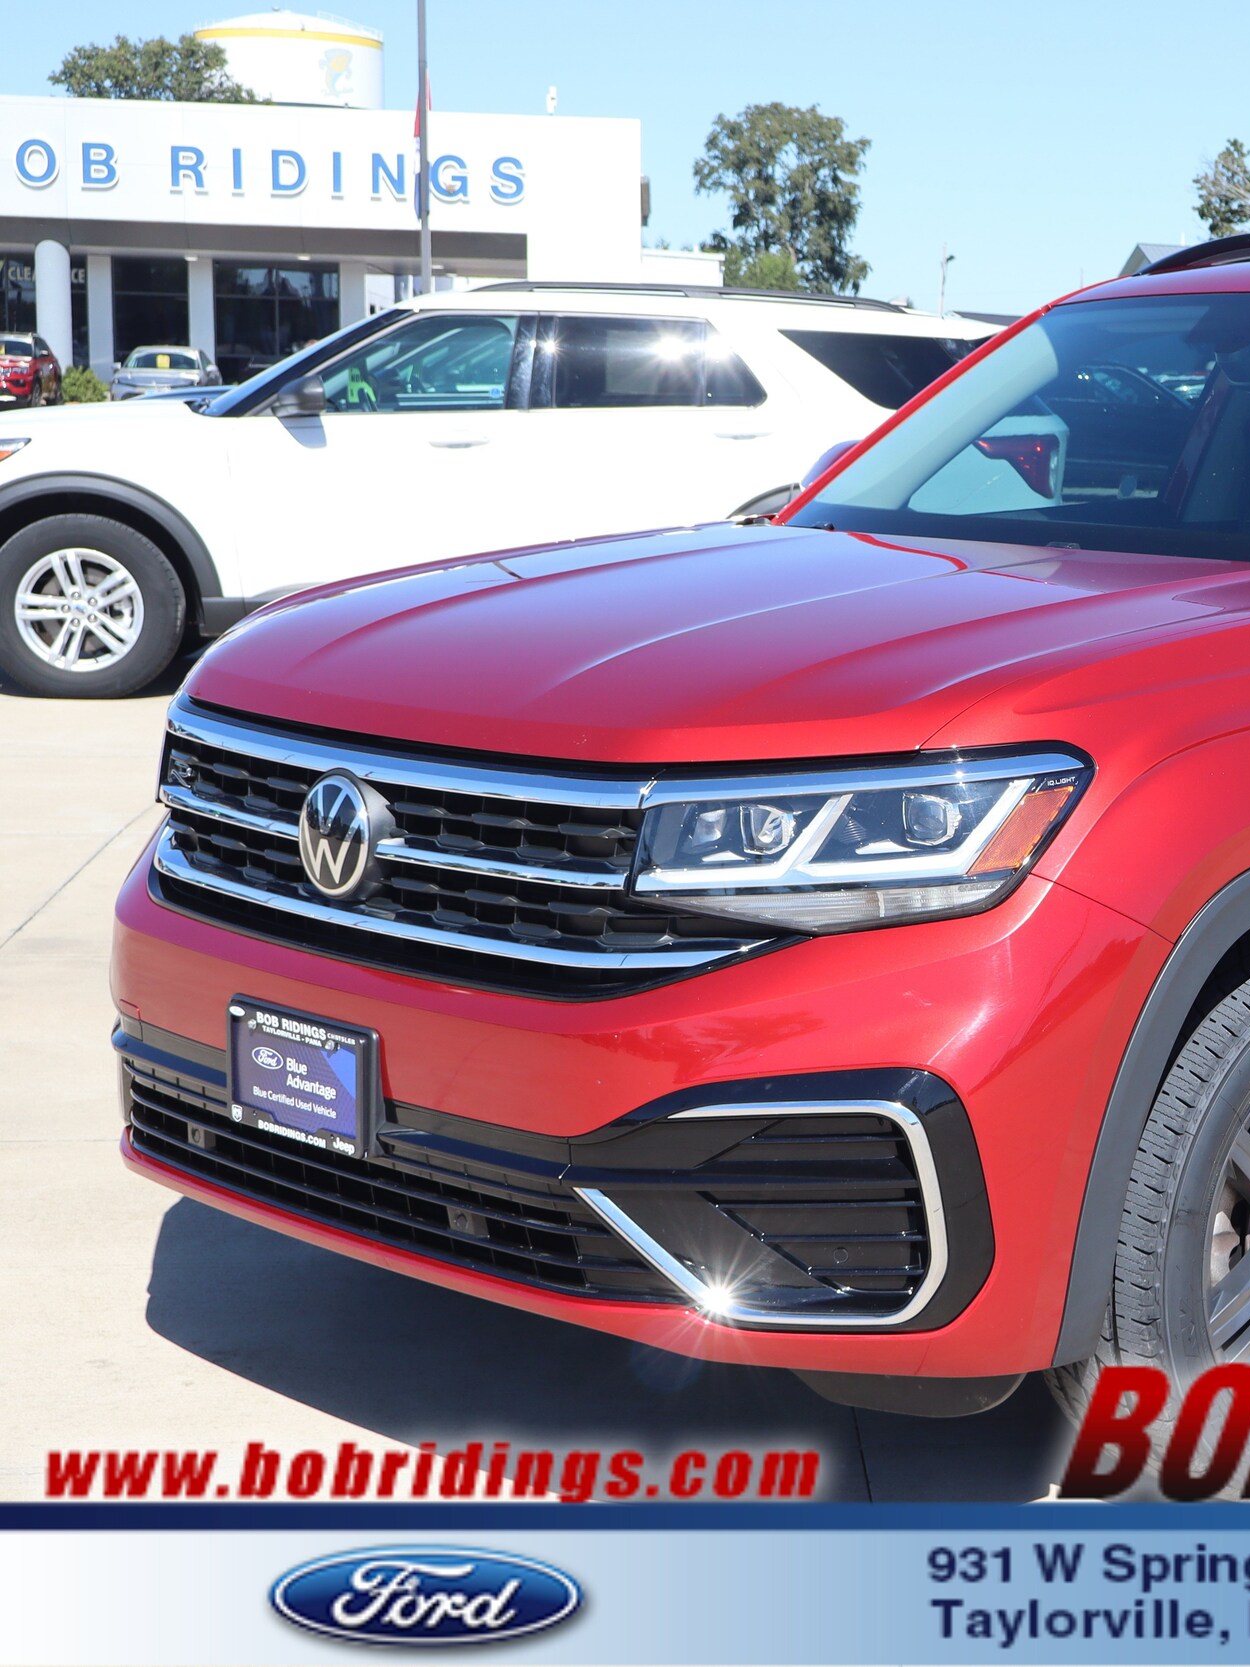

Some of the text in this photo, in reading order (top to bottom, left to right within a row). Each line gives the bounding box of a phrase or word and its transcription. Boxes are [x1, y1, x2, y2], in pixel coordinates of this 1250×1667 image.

[170, 146, 526, 203] RIDINGS
[256, 1011, 279, 1028] BOB
[281, 1018, 327, 1040] RIDINGS
[286, 1057, 308, 1076] Blue
[253, 1085, 337, 1119] Blue Certified Used Vehicle
[286, 1073, 337, 1101] Advantage
[258, 1119, 355, 1156] BOBRIDINGS.COM Jeep
